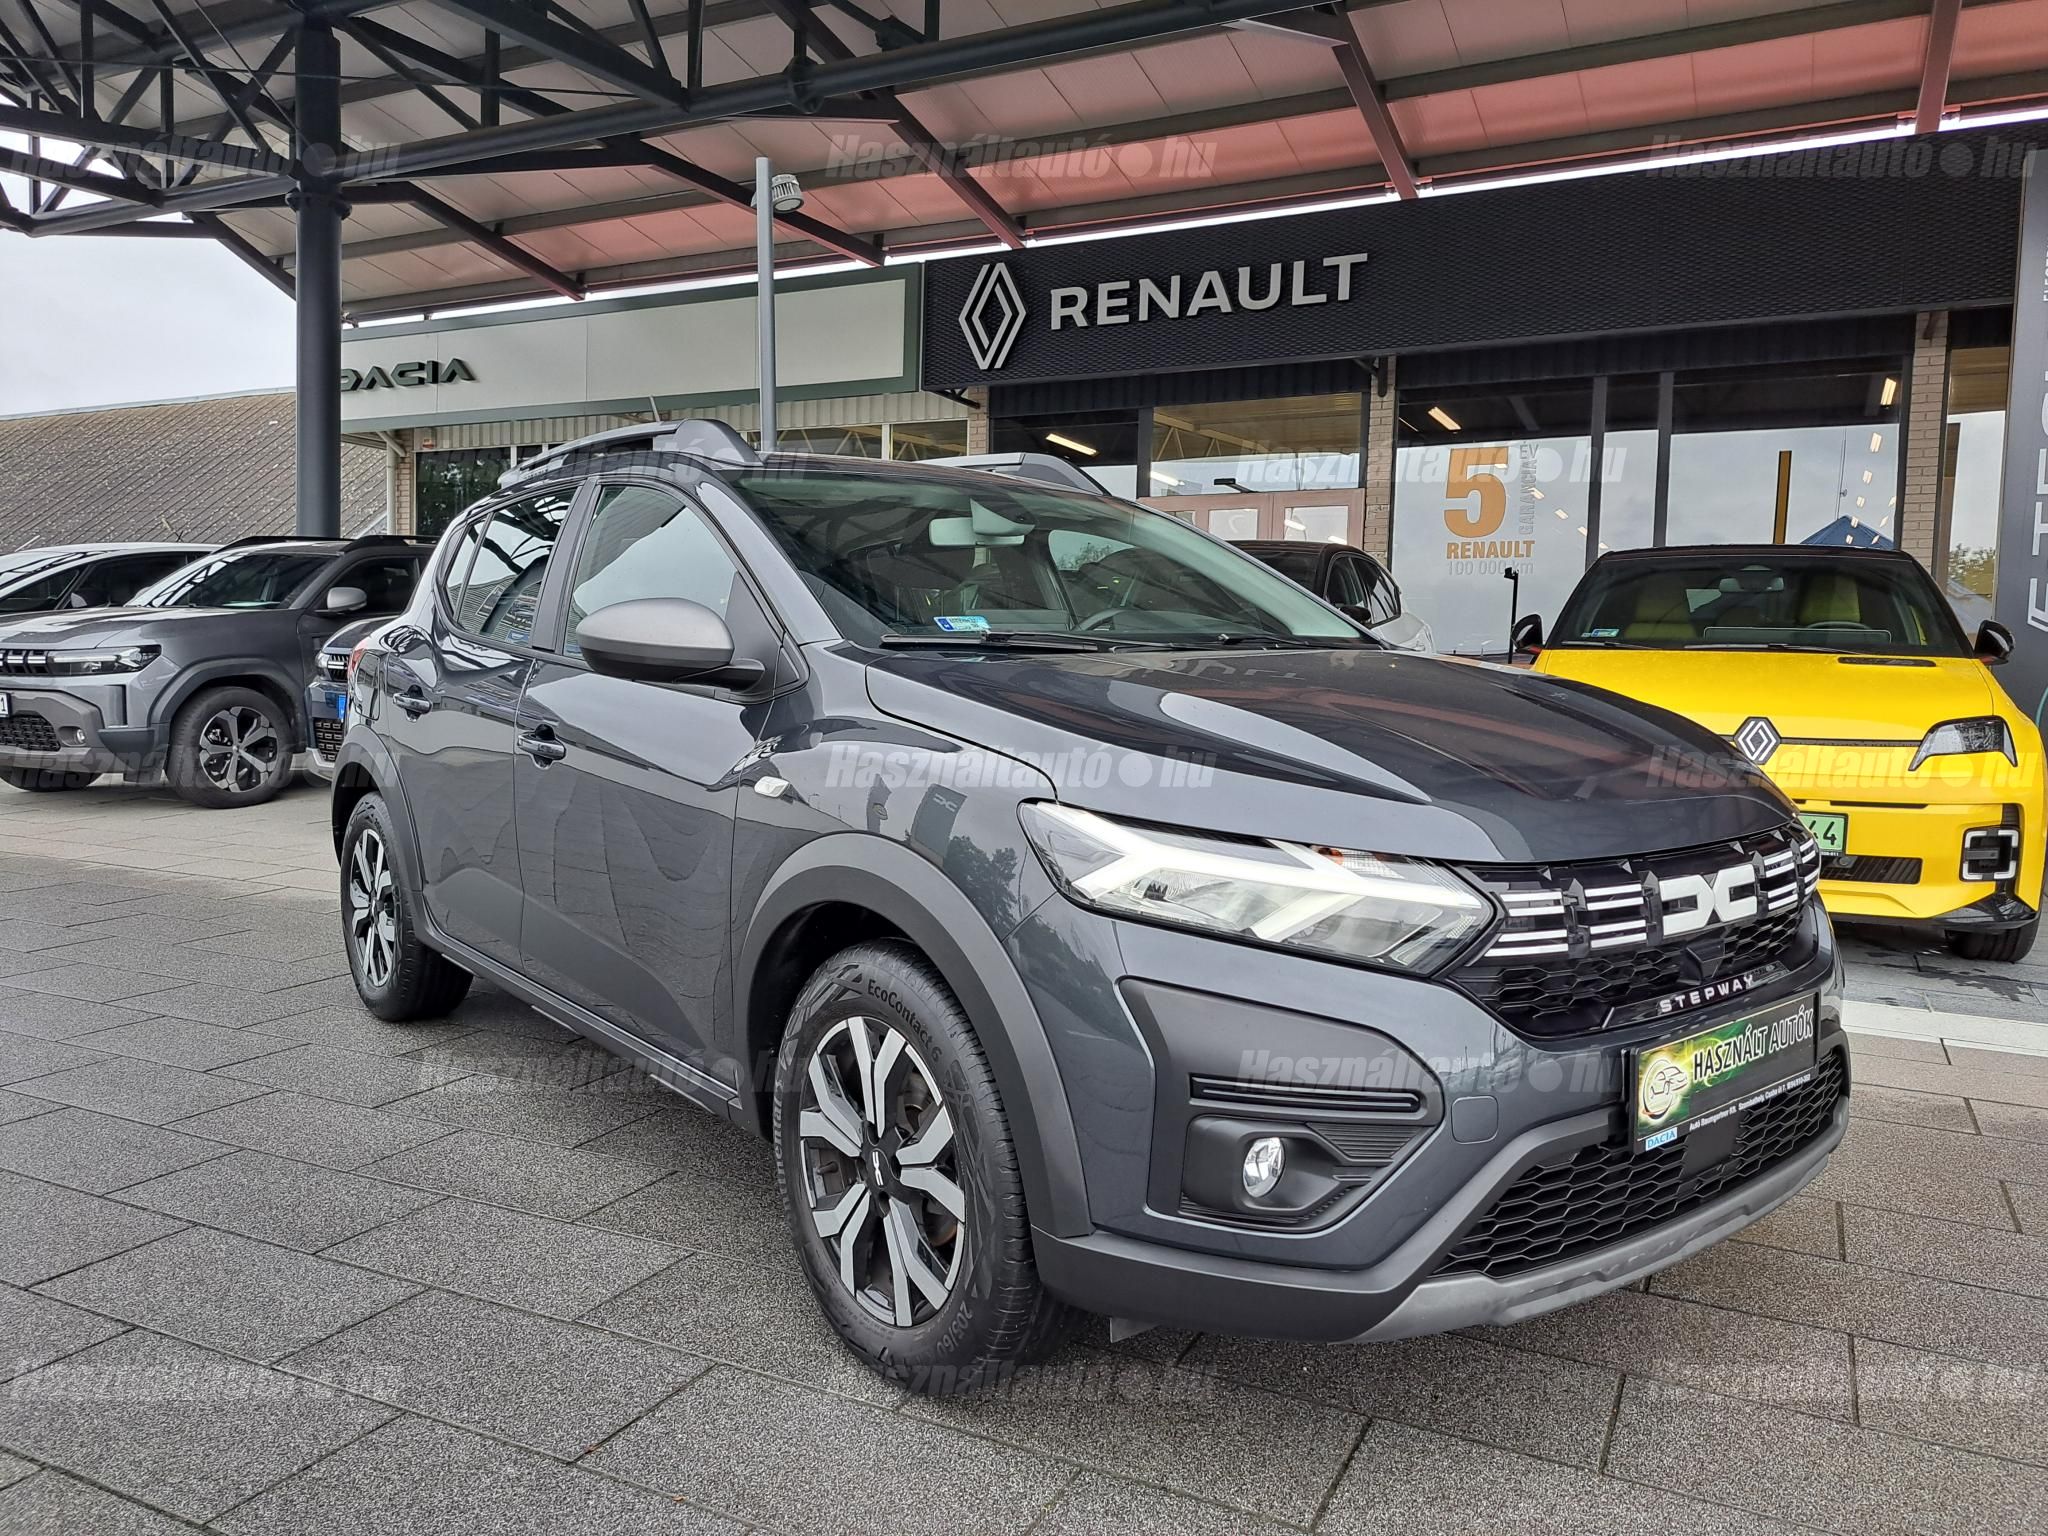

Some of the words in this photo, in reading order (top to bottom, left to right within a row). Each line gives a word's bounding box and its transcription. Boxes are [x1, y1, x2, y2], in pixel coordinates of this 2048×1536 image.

[1050, 252, 1368, 331] RENAULT
[1444, 446, 1509, 538] 5
[1446, 540, 1536, 560] RENAULT
[1447, 561, 1474, 576] 100
[867, 978, 933, 1050] EcoContact
[1659, 974, 1753, 1013] STEPWAY
[1692, 1024, 1769, 1083] HASZNÁLT
[1769, 1004, 1815, 1053] AUTÓK
[1647, 1131, 1677, 1149] DACIA
